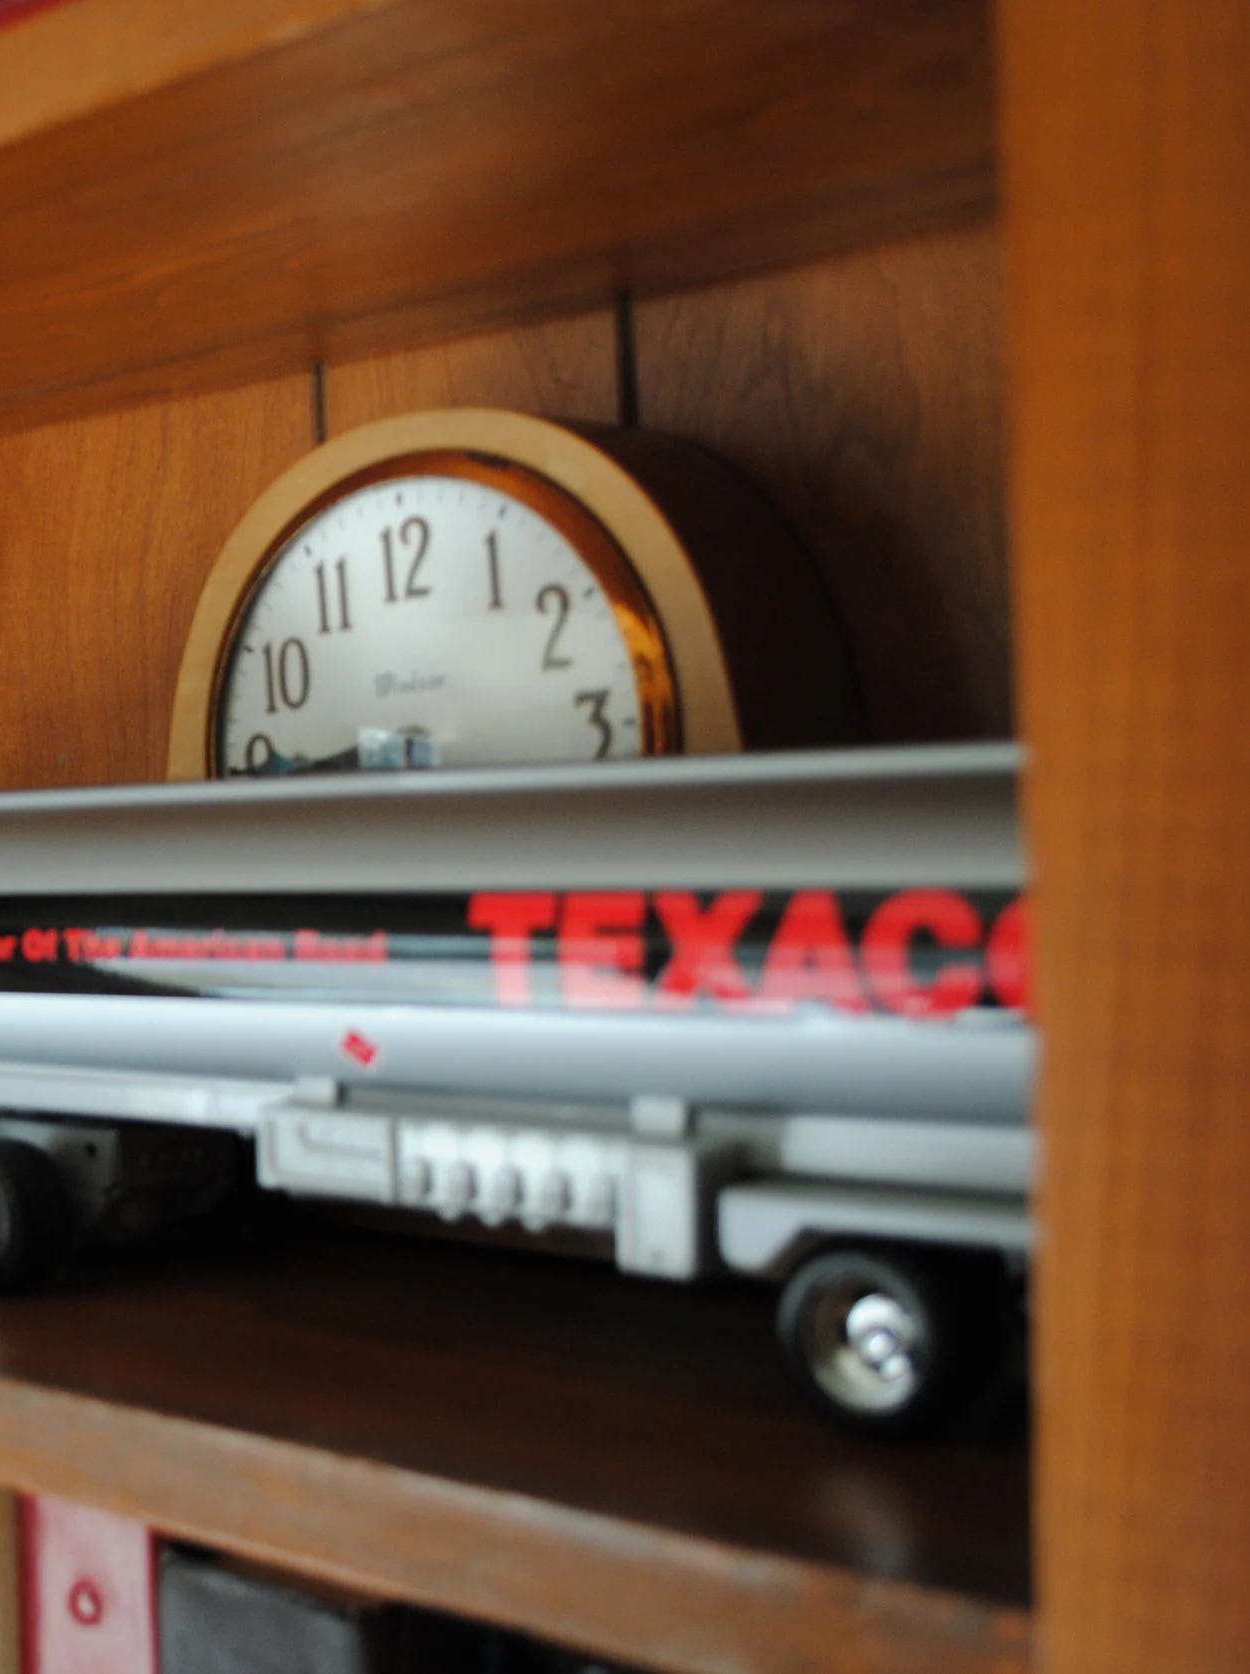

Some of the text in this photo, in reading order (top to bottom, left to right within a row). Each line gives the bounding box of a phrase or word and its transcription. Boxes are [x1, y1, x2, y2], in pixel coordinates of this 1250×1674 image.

[313, 555, 353, 635] 11
[377, 515, 433, 604] 12
[486, 530, 506, 611] 1
[536, 583, 573, 672] 2
[262, 637, 311, 714] 10
[573, 689, 613, 763] 3
[21, 925, 59, 963] Of
[63, 925, 122, 963] The
[128, 926, 287, 963] American
